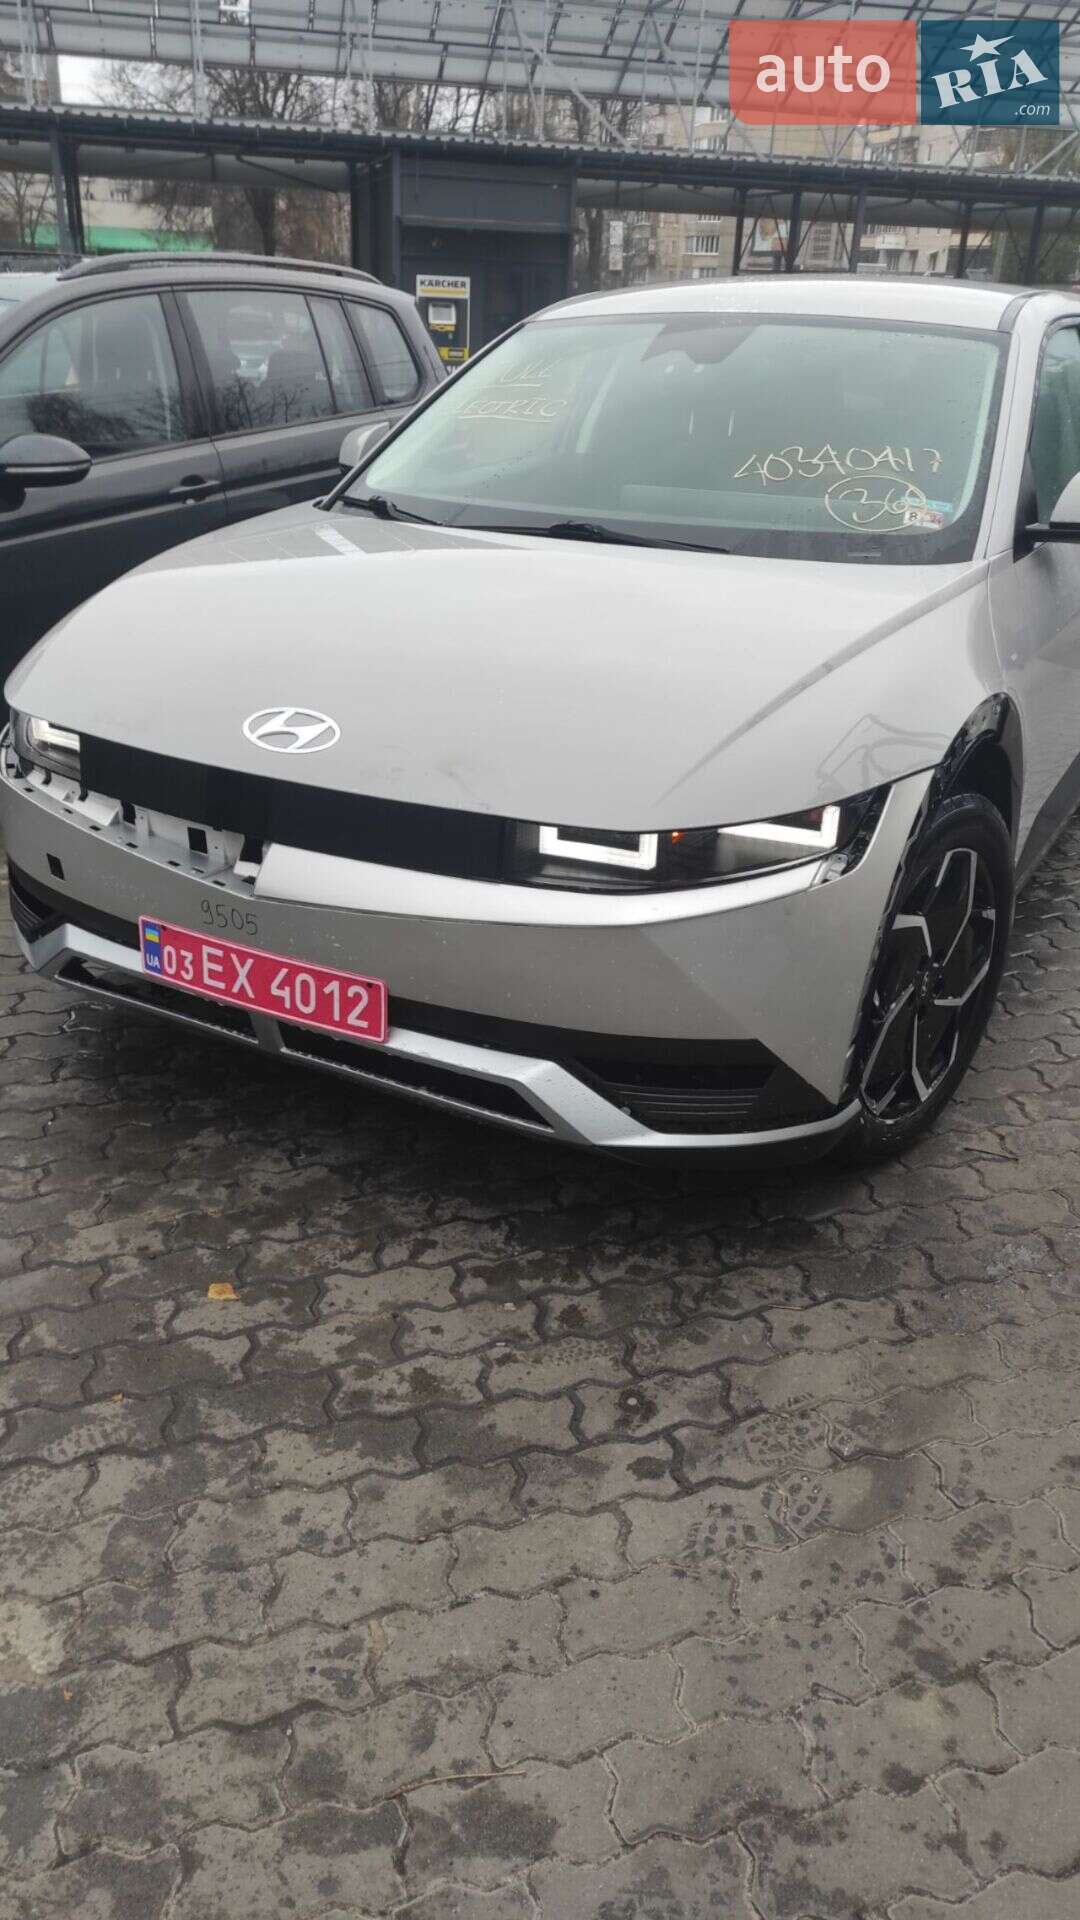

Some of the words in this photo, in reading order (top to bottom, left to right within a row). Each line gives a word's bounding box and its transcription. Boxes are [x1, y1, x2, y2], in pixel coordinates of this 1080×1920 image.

[200, 899, 258, 936] 9505
[146, 953, 161, 970] UA
[163, 945, 194, 981] 03
[202, 944, 255, 1000] EX
[270, 968, 369, 1029] 4012
